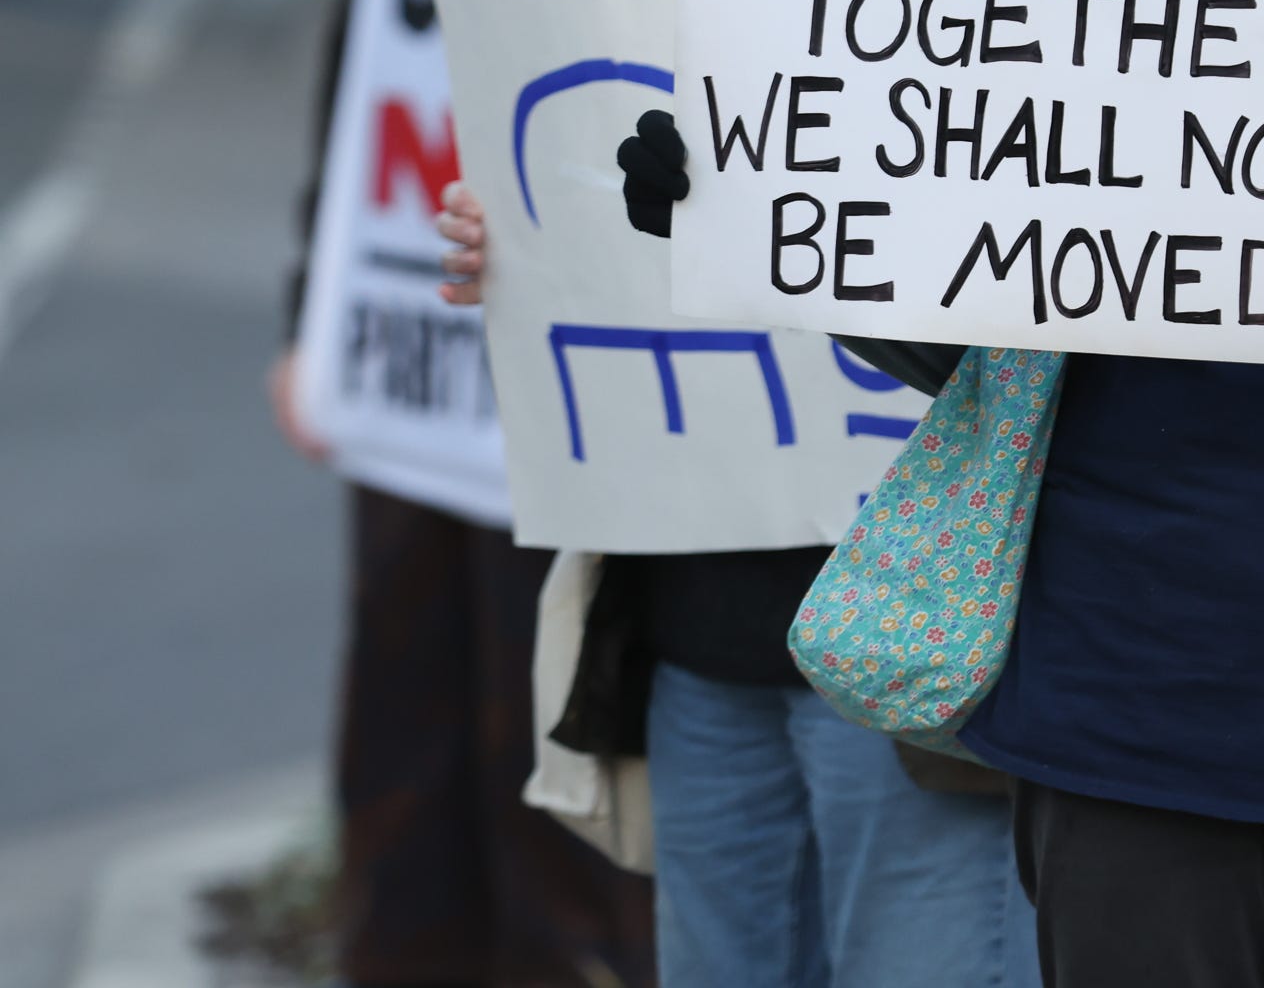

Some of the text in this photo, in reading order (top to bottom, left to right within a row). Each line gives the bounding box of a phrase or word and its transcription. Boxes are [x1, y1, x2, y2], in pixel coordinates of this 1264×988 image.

[703, 71, 844, 173] WE
[875, 77, 1144, 189] SHALL
[770, 191, 895, 303] BE
